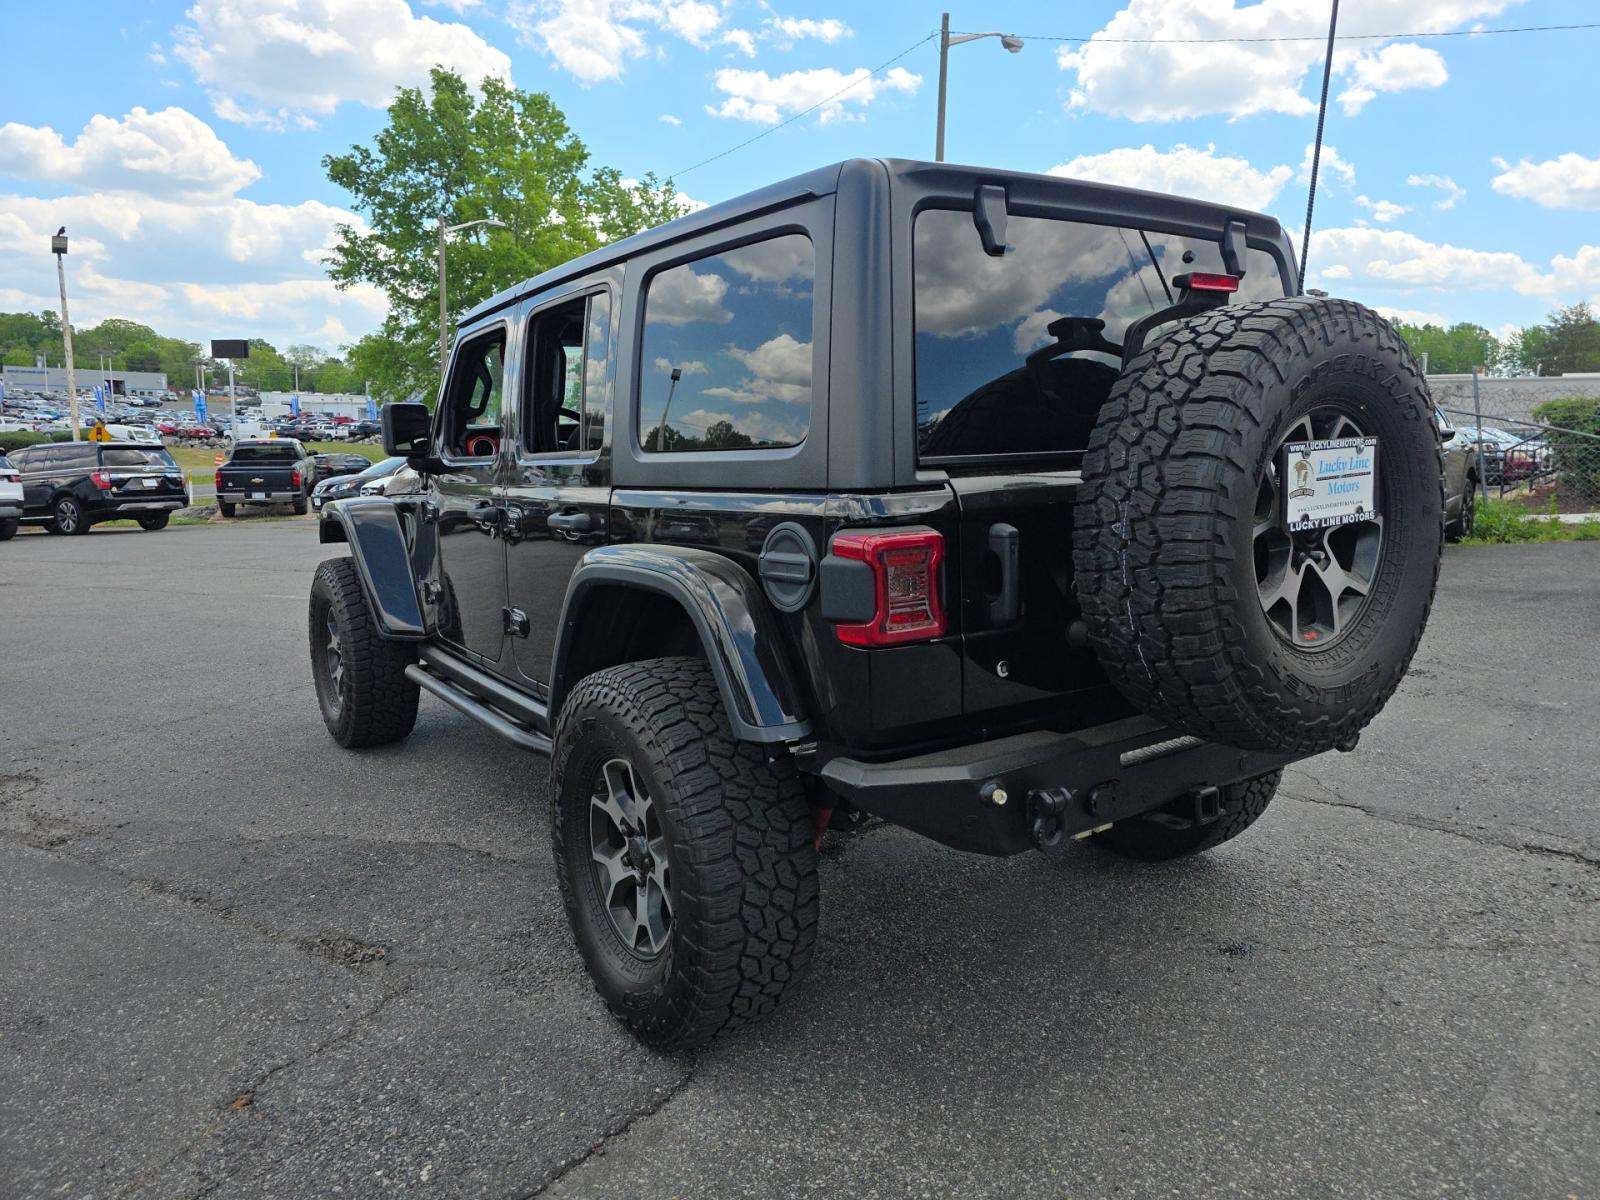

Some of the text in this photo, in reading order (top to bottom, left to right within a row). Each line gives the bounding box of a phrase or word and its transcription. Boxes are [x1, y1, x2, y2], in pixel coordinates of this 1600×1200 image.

[1318, 456, 1370, 474] Lucky Line
[1327, 481, 1360, 496] Motors
[1290, 511, 1375, 532] LUCKY LINE MOTORS
